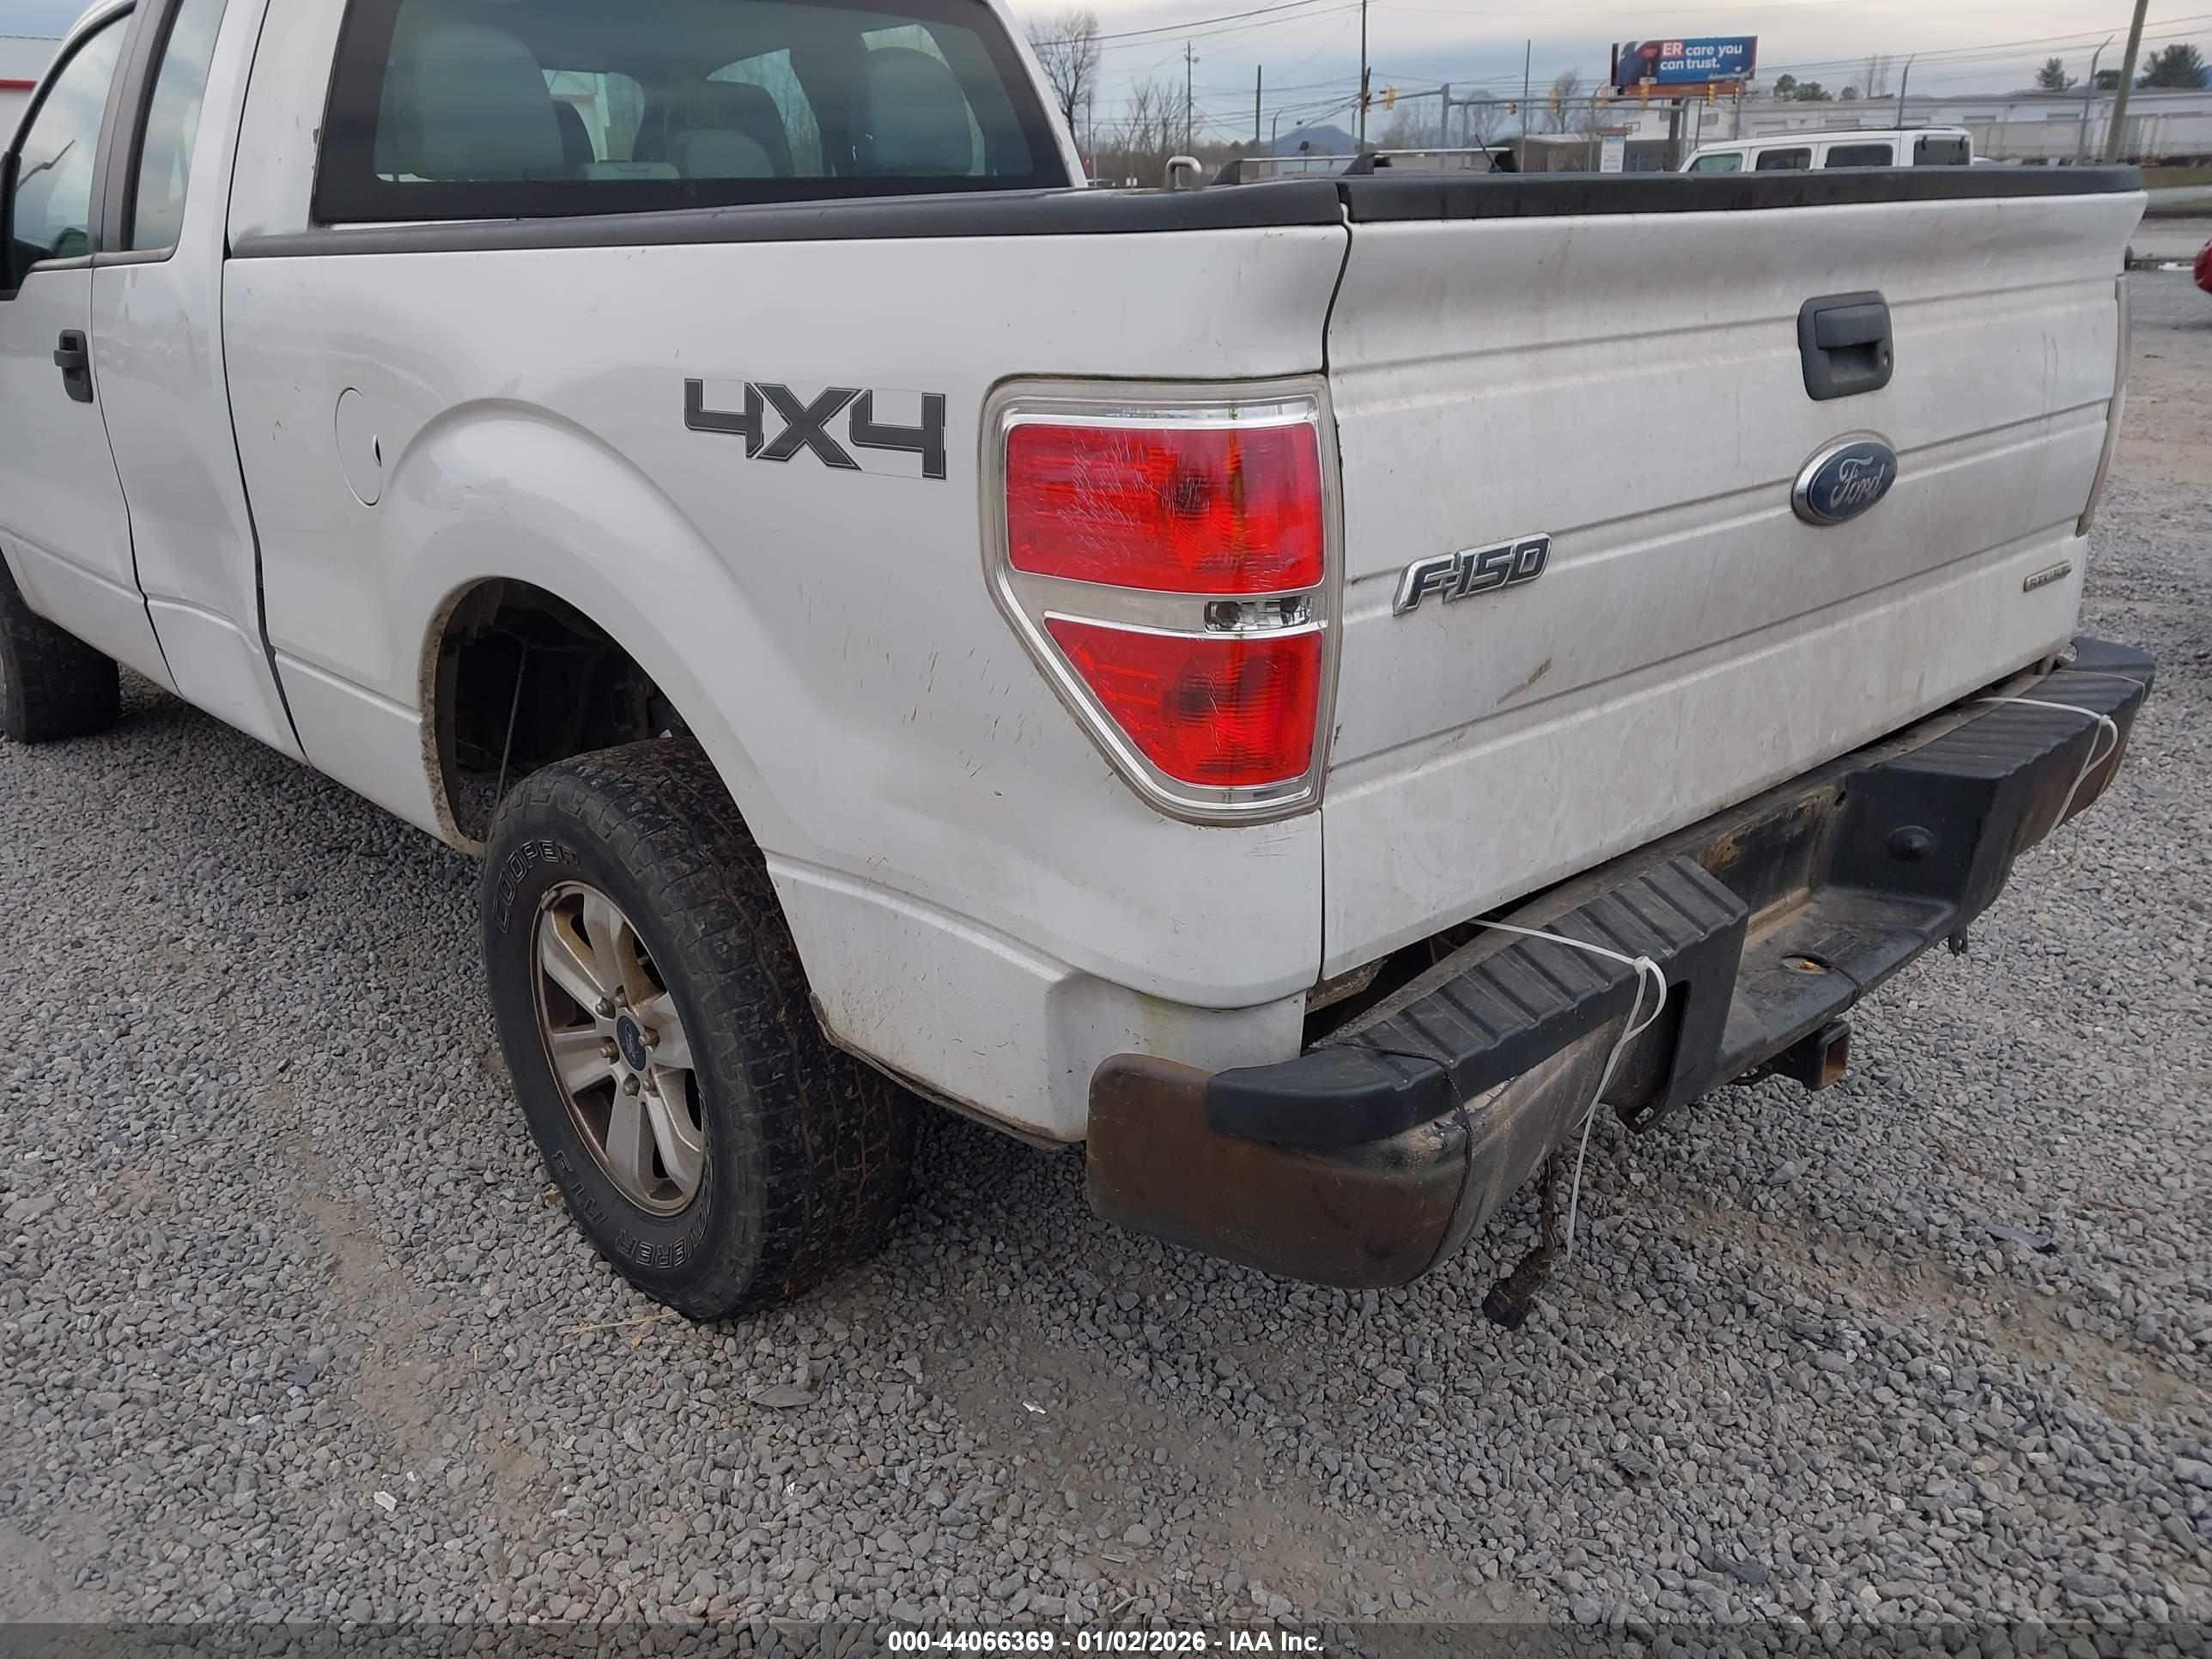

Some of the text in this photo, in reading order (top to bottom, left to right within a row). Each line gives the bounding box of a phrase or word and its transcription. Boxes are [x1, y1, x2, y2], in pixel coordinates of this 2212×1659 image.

[1660, 58, 1720, 70] can trust.
[1662, 42, 1742, 58] ER care you
[1830, 455, 1885, 508] Ford
[1393, 532, 1552, 617] F-150
[493, 839, 581, 934] COOPER
